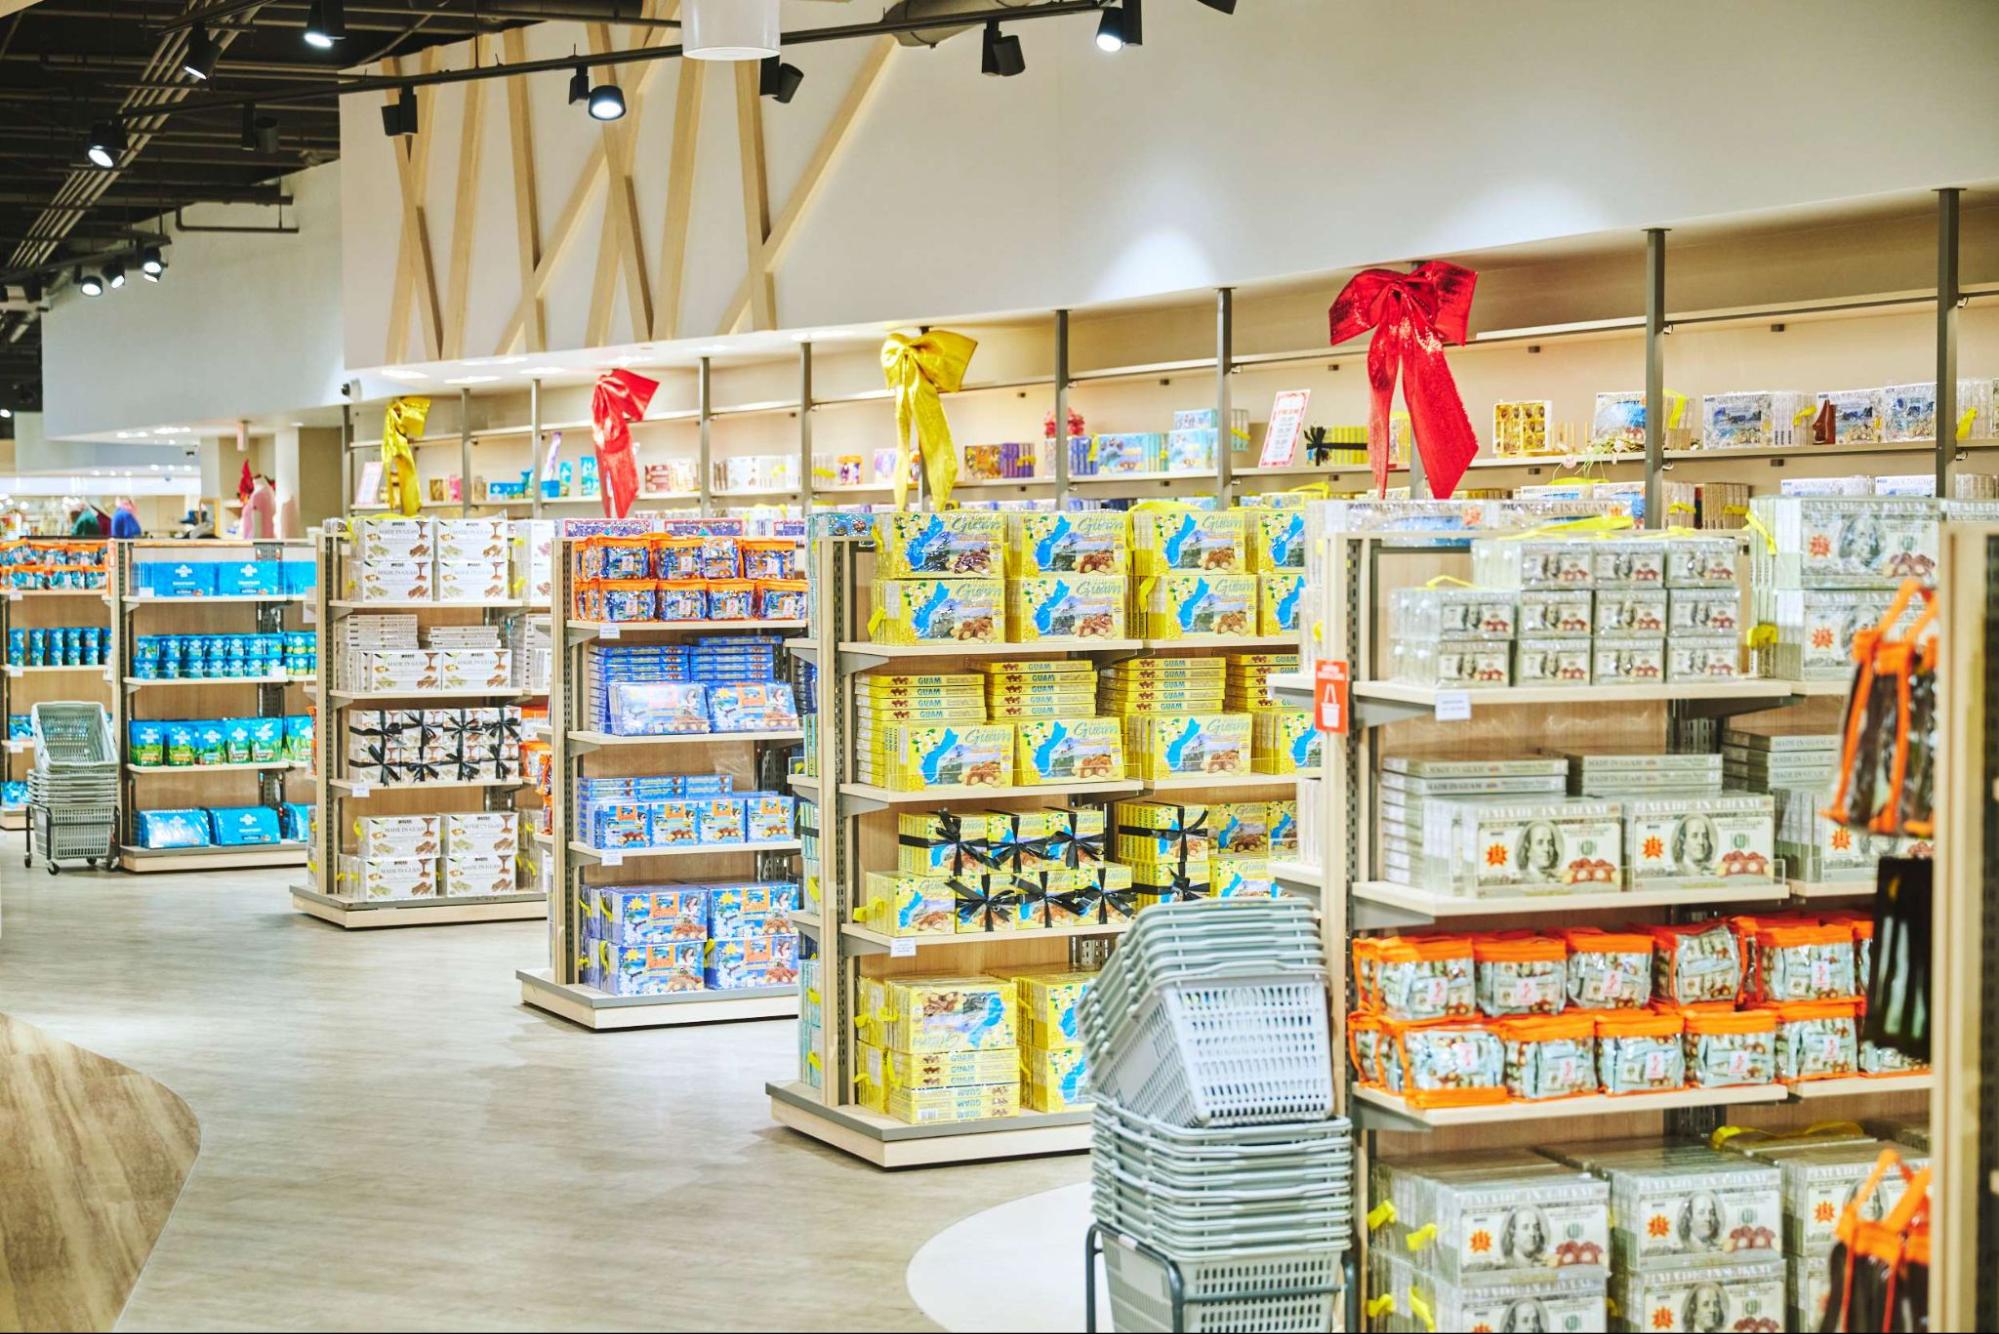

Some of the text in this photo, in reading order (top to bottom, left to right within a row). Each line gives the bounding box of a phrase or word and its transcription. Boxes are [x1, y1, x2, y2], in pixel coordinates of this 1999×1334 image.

[1163, 659, 1185, 667] GUAM
[1275, 655, 1297, 663] GUAM
[1028, 663, 1050, 671] GUAM
[1032, 674, 1055, 682] GUAM
[1163, 670, 1185, 678] GUAM
[917, 676, 942, 685] GUAM
[1031, 685, 1053, 693] GUAM
[1163, 681, 1185, 689] GUAM
[917, 687, 941, 696] GUAM
[1163, 691, 1185, 699] GUAM
[918, 699, 941, 707] GUAM
[1030, 696, 1053, 704] GUAM
[1160, 702, 1183, 710] GUAM
[920, 710, 943, 718] GUAM
[1031, 706, 1053, 715] GUAM
[1649, 799, 1687, 812] MADE
[1716, 796, 1760, 810] GUAM
[1491, 801, 1608, 819] MADE IN GUAM
